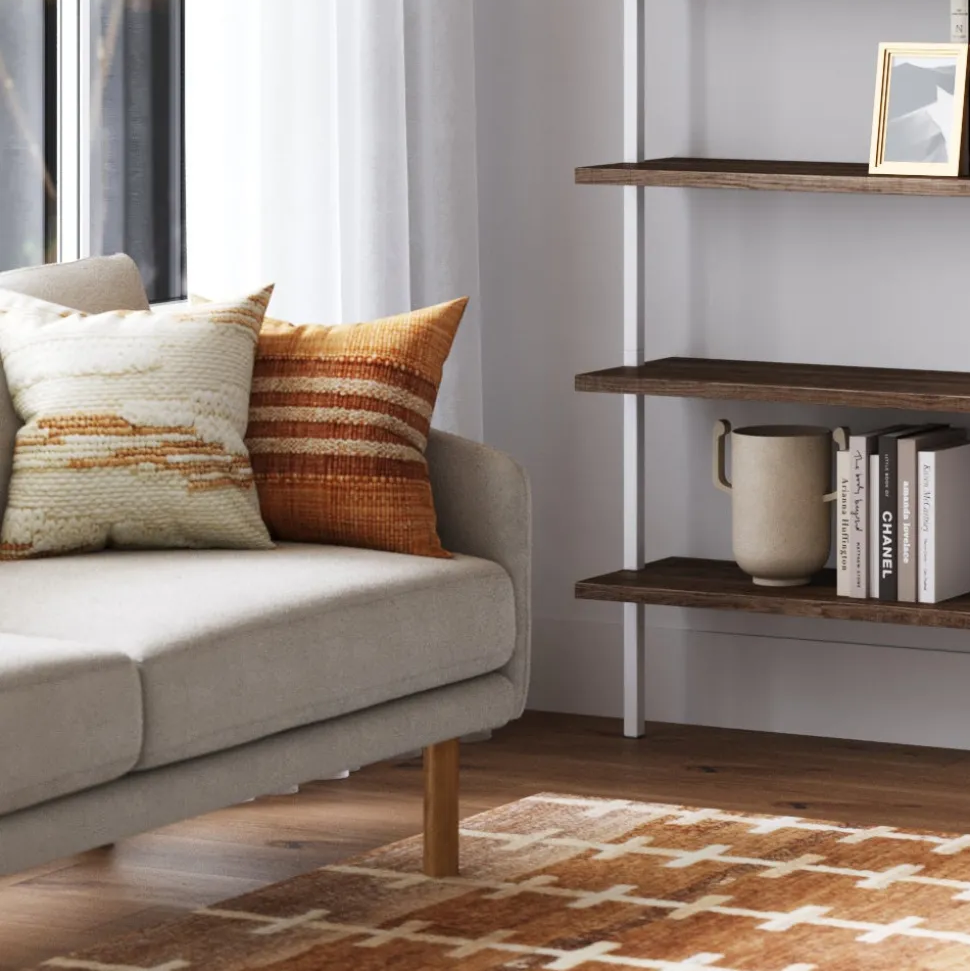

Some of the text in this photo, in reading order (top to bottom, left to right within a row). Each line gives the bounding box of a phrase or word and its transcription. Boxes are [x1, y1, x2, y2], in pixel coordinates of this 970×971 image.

[840, 478, 850, 571] Arianna Huffington
[881, 510, 893, 579] CHANEL
[903, 480, 911, 564] amanda lovelace
